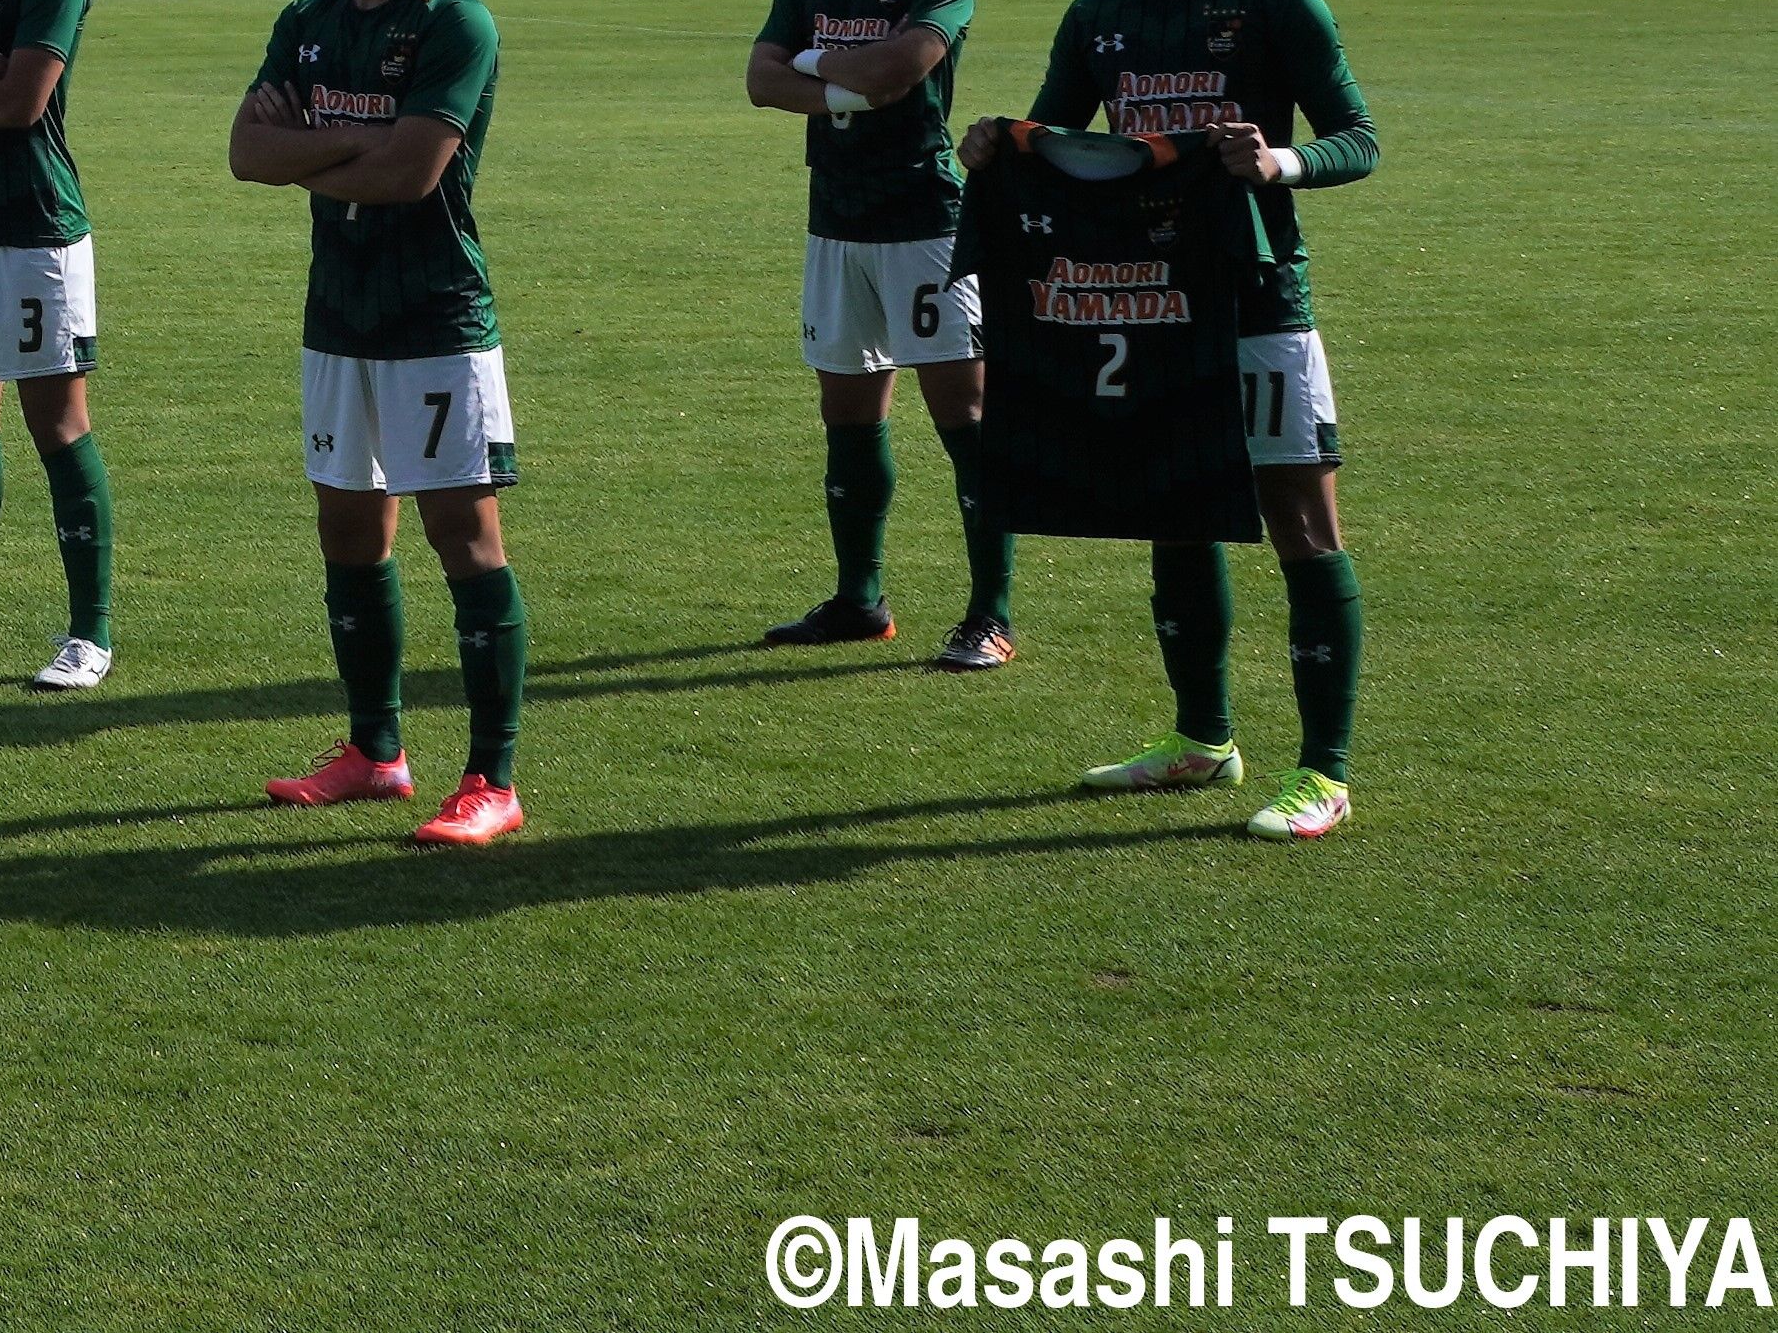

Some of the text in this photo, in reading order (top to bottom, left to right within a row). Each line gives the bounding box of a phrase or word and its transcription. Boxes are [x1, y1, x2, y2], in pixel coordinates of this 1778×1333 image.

[310, 84, 397, 119] AOMORI
[1116, 71, 1227, 102] AOMORI
[1106, 98, 1242, 135] YAMADA
[1046, 256, 1170, 289] AOMORI
[19, 298, 43, 353] 3
[912, 283, 939, 338] 6
[1028, 279, 1192, 326] YAMADA
[1095, 333, 1127, 398] 2
[423, 392, 451, 459] 7
[1242, 371, 1285, 438] 11
